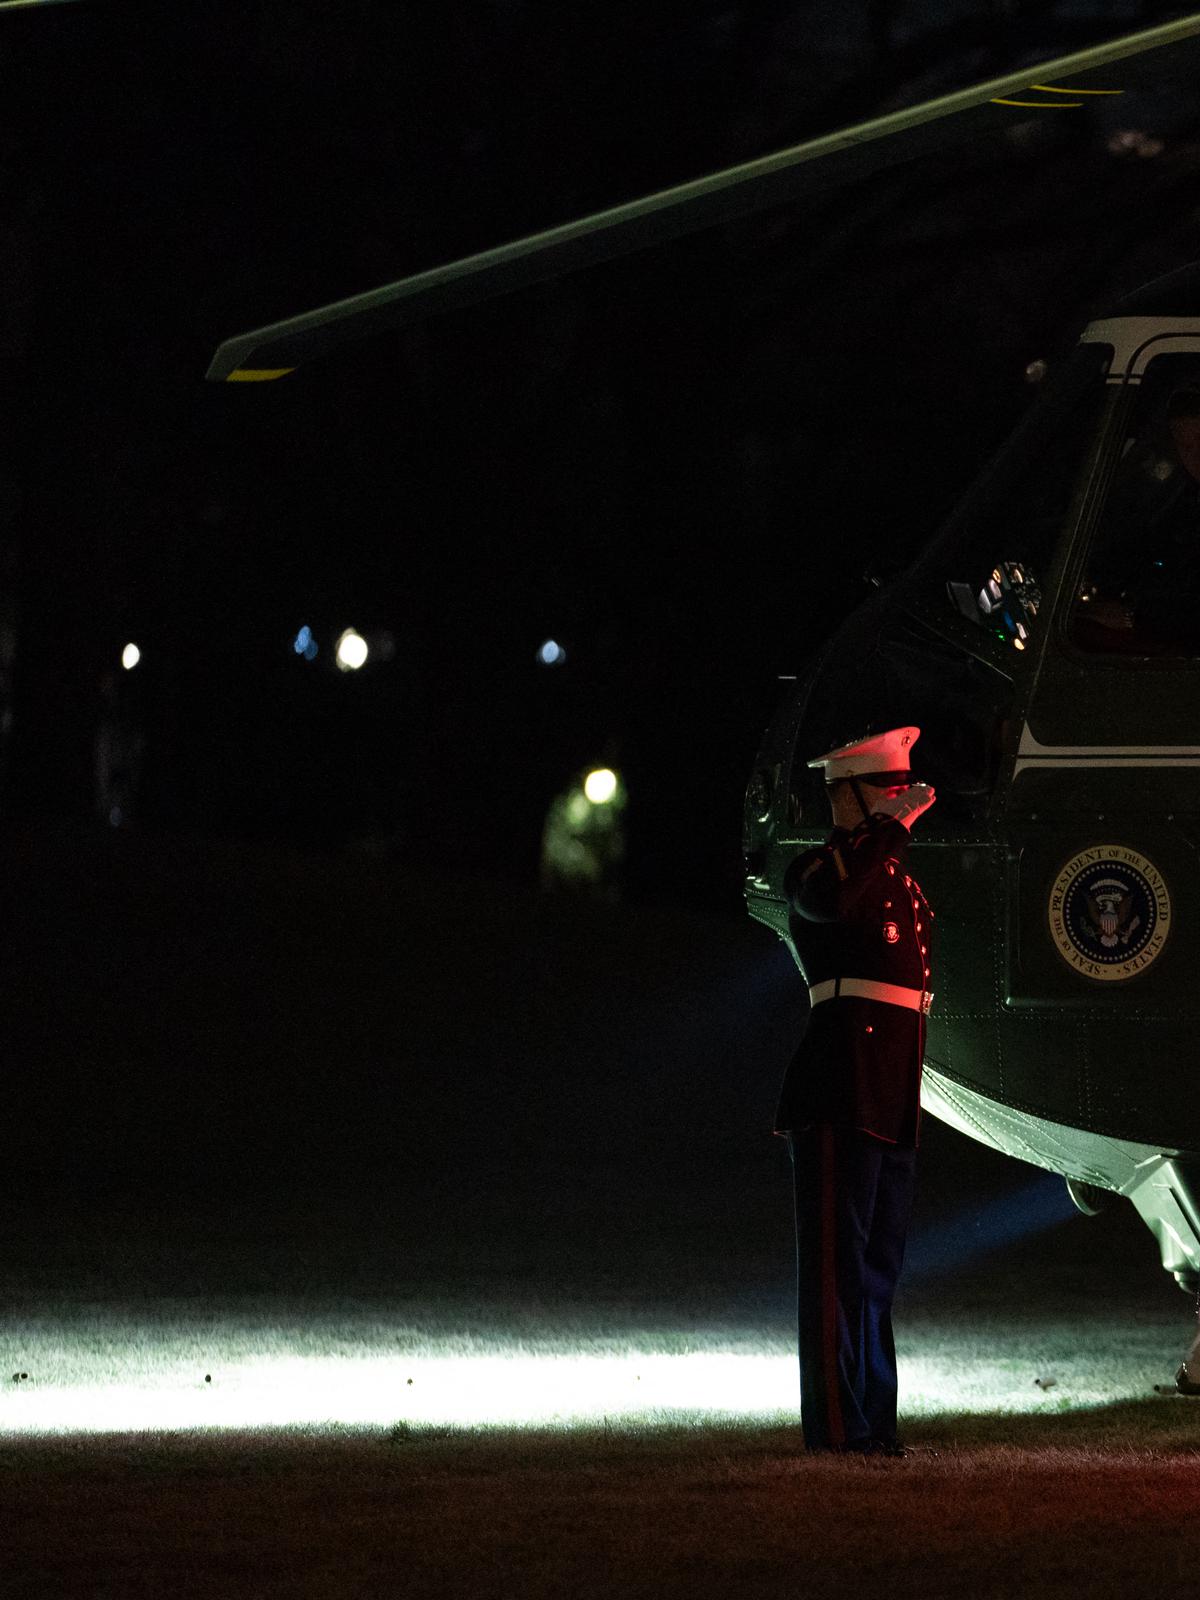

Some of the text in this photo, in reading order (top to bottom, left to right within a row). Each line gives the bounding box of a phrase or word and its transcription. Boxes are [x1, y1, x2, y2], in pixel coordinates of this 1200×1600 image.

[1052, 849, 1168, 975] SEAL OF THE PRESIDENT OF THE UNITED STATES
